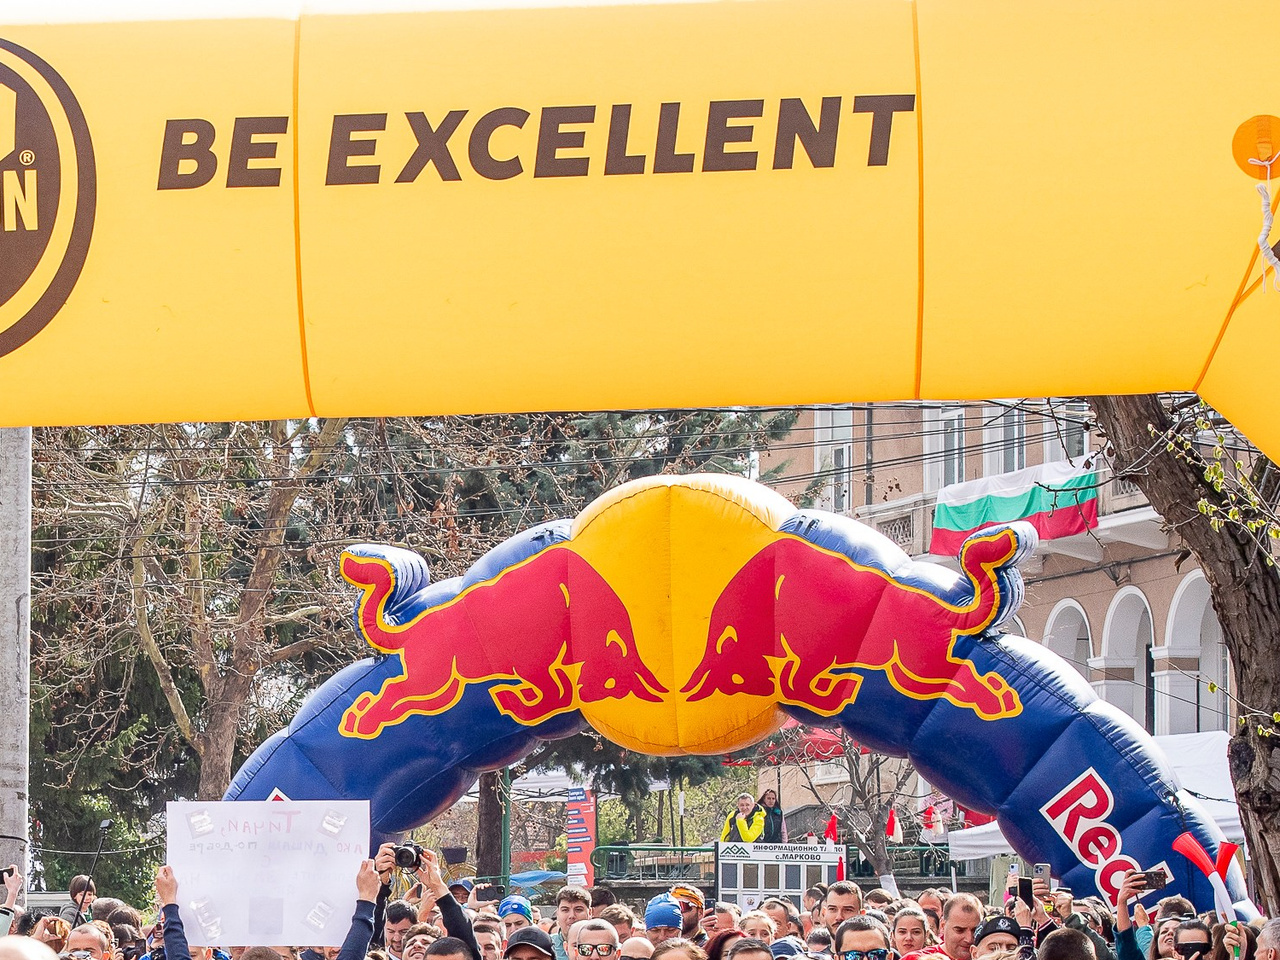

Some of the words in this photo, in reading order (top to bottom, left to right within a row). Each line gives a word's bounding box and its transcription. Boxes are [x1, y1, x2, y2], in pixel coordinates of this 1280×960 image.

[156, 115, 290, 191] BE
[324, 94, 917, 187] EXCELLENT
[753, 844, 818, 852] ИНФОРМАЦИОННО
[775, 853, 821, 861] с.МАРКОВО
